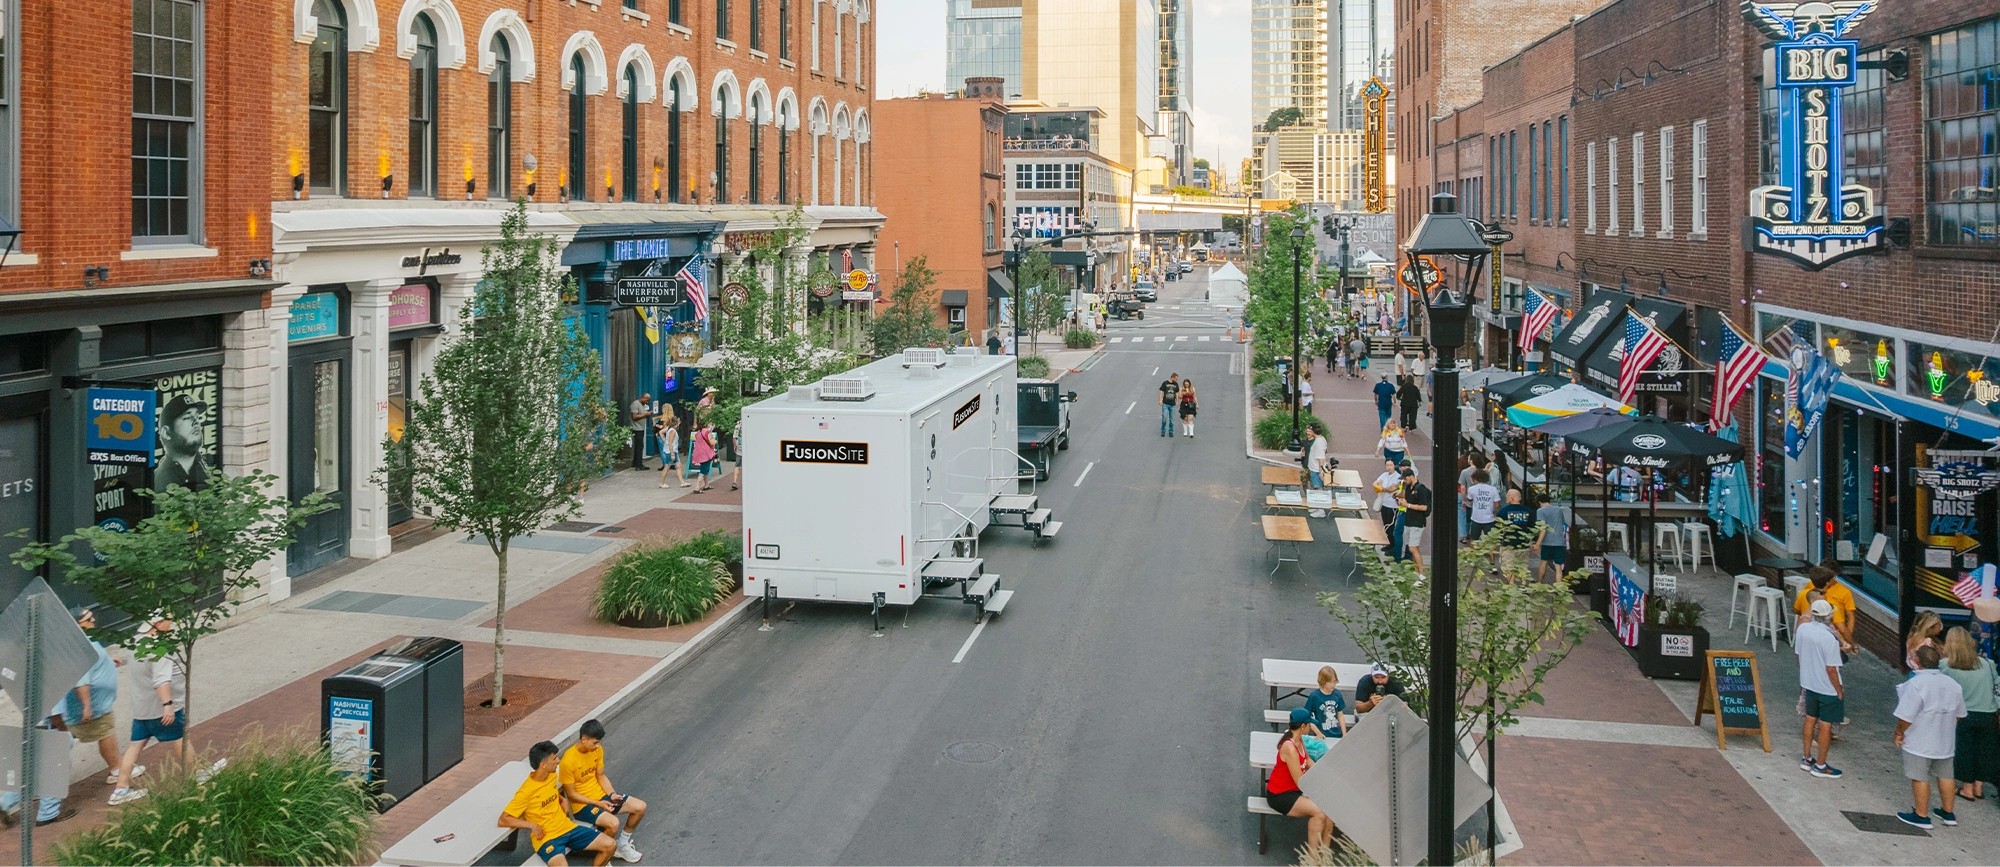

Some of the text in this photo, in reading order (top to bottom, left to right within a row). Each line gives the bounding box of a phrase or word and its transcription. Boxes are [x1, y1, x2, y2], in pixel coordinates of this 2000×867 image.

[1787, 48, 1848, 81] BIG
[1804, 88, 1828, 224] SHOTZ
[1830, 225, 1850, 235] SINCE
[1850, 225, 1867, 235] 2009
[615, 239, 669, 260] THE DANIEL
[859, 274, 875, 284] Rock
[1492, 245, 1501, 309] MERCANTILE
[620, 288, 676, 296] RIVERFRONT
[289, 300, 321, 311] PPAREL
[391, 293, 425, 308] DHORSE
[289, 312, 315, 323] GIFTS
[388, 310, 406, 318] UPPLY
[289, 323, 327, 335] UVENIRS
[1834, 345, 1851, 367] Lite
[388, 361, 399, 369] ILD
[1647, 383, 1682, 392] STILLERY
[1976, 380, 1999, 406] Lite
[93, 398, 145, 412] CATEGORY
[377, 401, 387, 412] 114
[94, 413, 144, 441] 10
[1944, 415, 1959, 429] 115
[110, 453, 123, 462] Box
[124, 453, 147, 463] Office
[1641, 456, 1669, 468] Smoky
[93, 464, 128, 481] SPIRITS
[1942, 478, 1980, 487] BIG SHOTZ
[1477, 488, 1490, 496] live
[95, 487, 125, 513] SPORT
[1932, 500, 1975, 516] RAISE
[1930, 515, 1979, 534] HELL
[1714, 658, 1750, 668] FREE BEER
[1726, 667, 1742, 676] AND
[333, 701, 369, 710] NASHVILLE
[341, 709, 369, 717] RECYCLES
[541, 794, 558, 808] BARÇA
